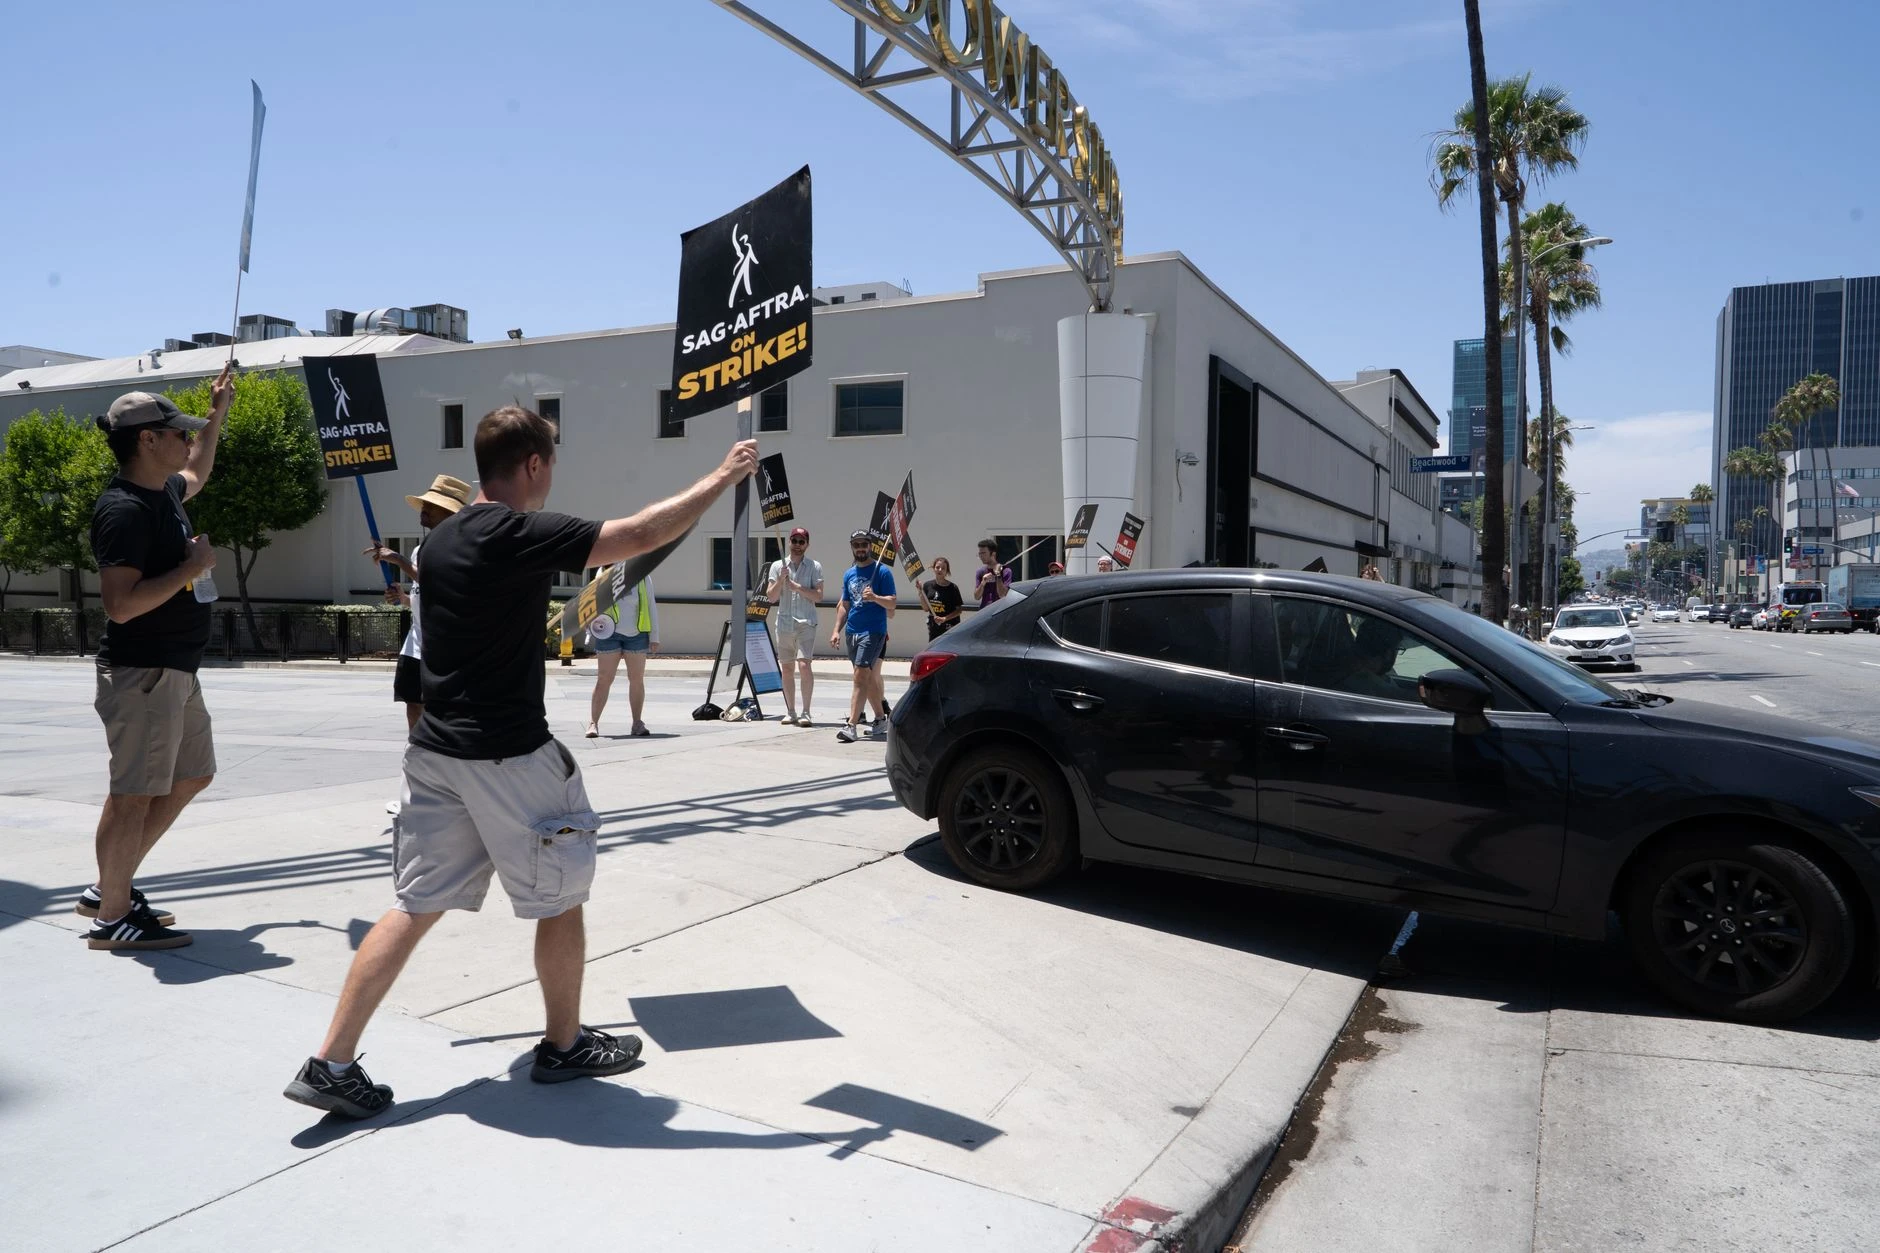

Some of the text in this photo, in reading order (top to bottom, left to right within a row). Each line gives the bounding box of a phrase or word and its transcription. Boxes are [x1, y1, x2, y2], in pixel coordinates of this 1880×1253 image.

[871, 0, 1071, 159] OWER
[730, 330, 756, 353] ON
[677, 321, 807, 400] STRIKE!
[343, 439, 358, 448] ON
[325, 444, 392, 467] STRIKE!
[1412, 456, 1457, 467] Beachwood
[763, 504, 792, 522] STRIKE!
[871, 542, 896, 560] TRKE!
